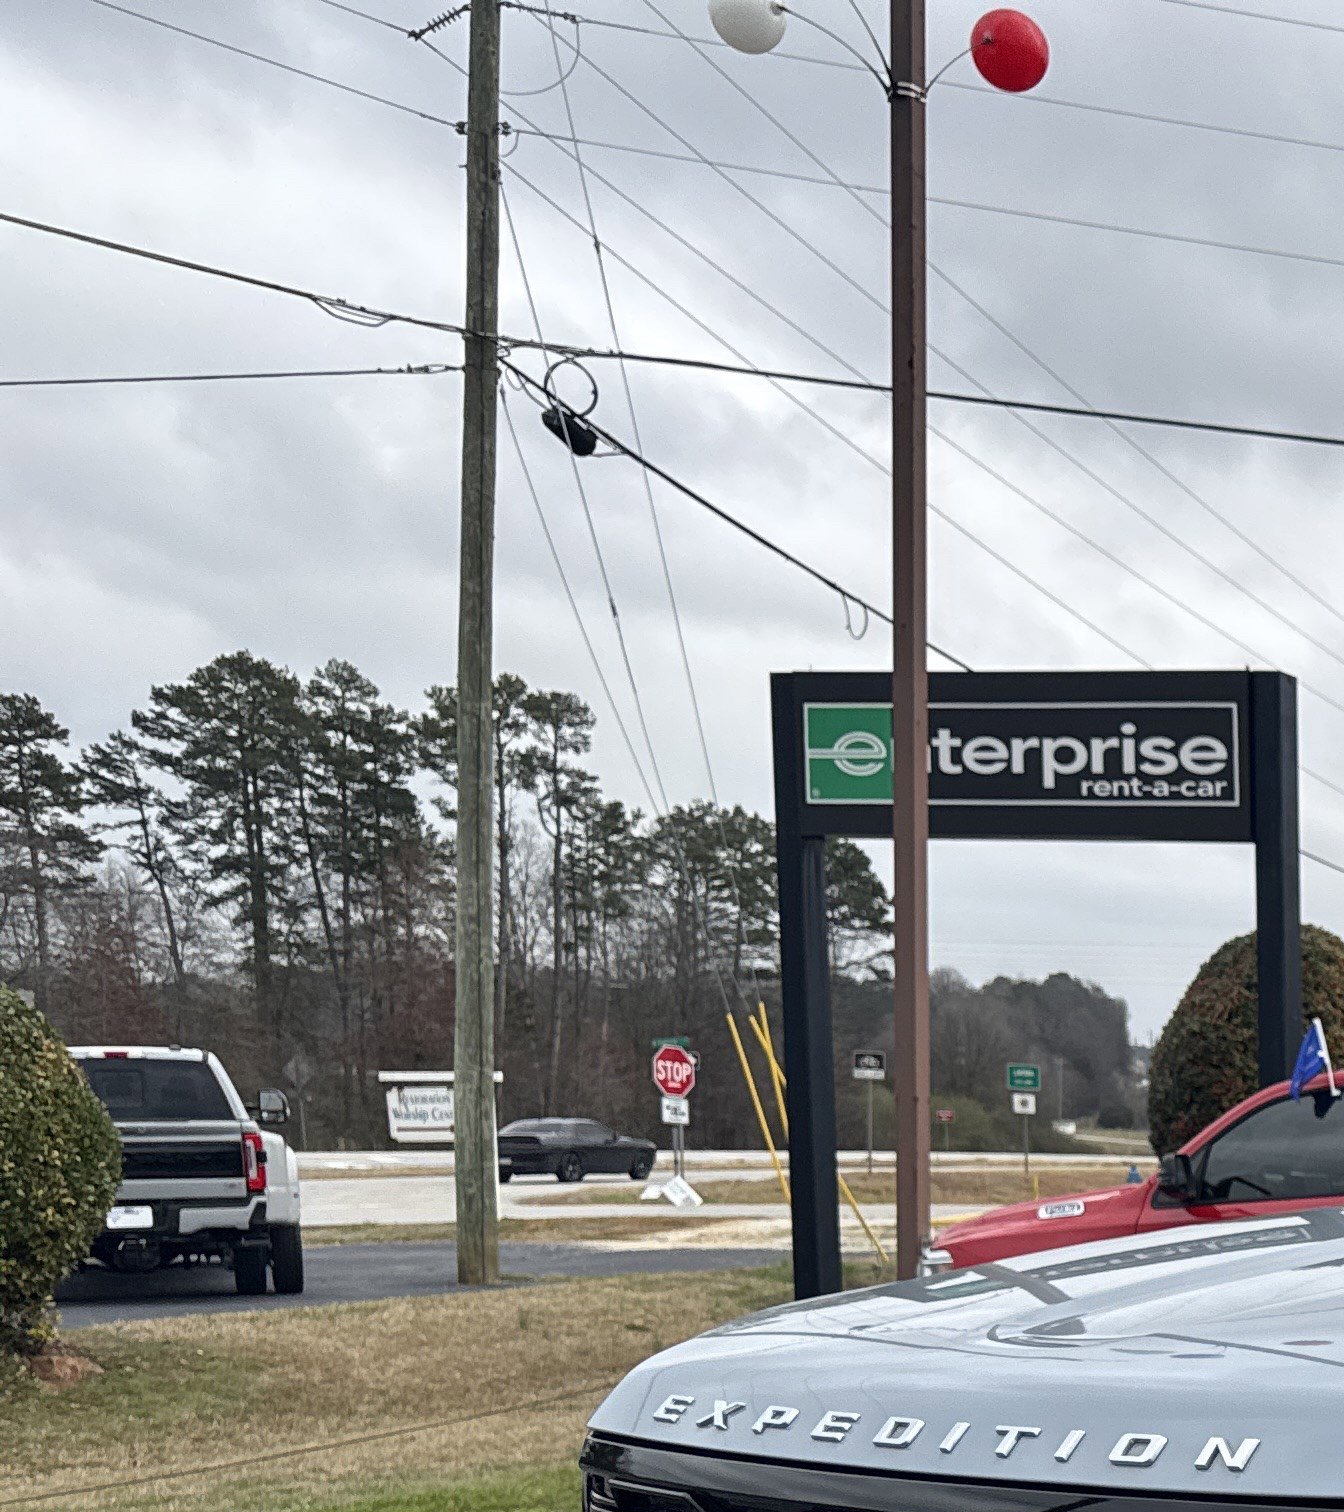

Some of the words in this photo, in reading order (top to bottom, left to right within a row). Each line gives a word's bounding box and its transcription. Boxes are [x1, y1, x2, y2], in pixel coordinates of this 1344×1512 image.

[810, 722, 1228, 789] eterprise
[1080, 776, 1228, 799] rent-a-car
[657, 1059, 692, 1083] STOP
[652, 1394, 1261, 1472] EXPEDITION
